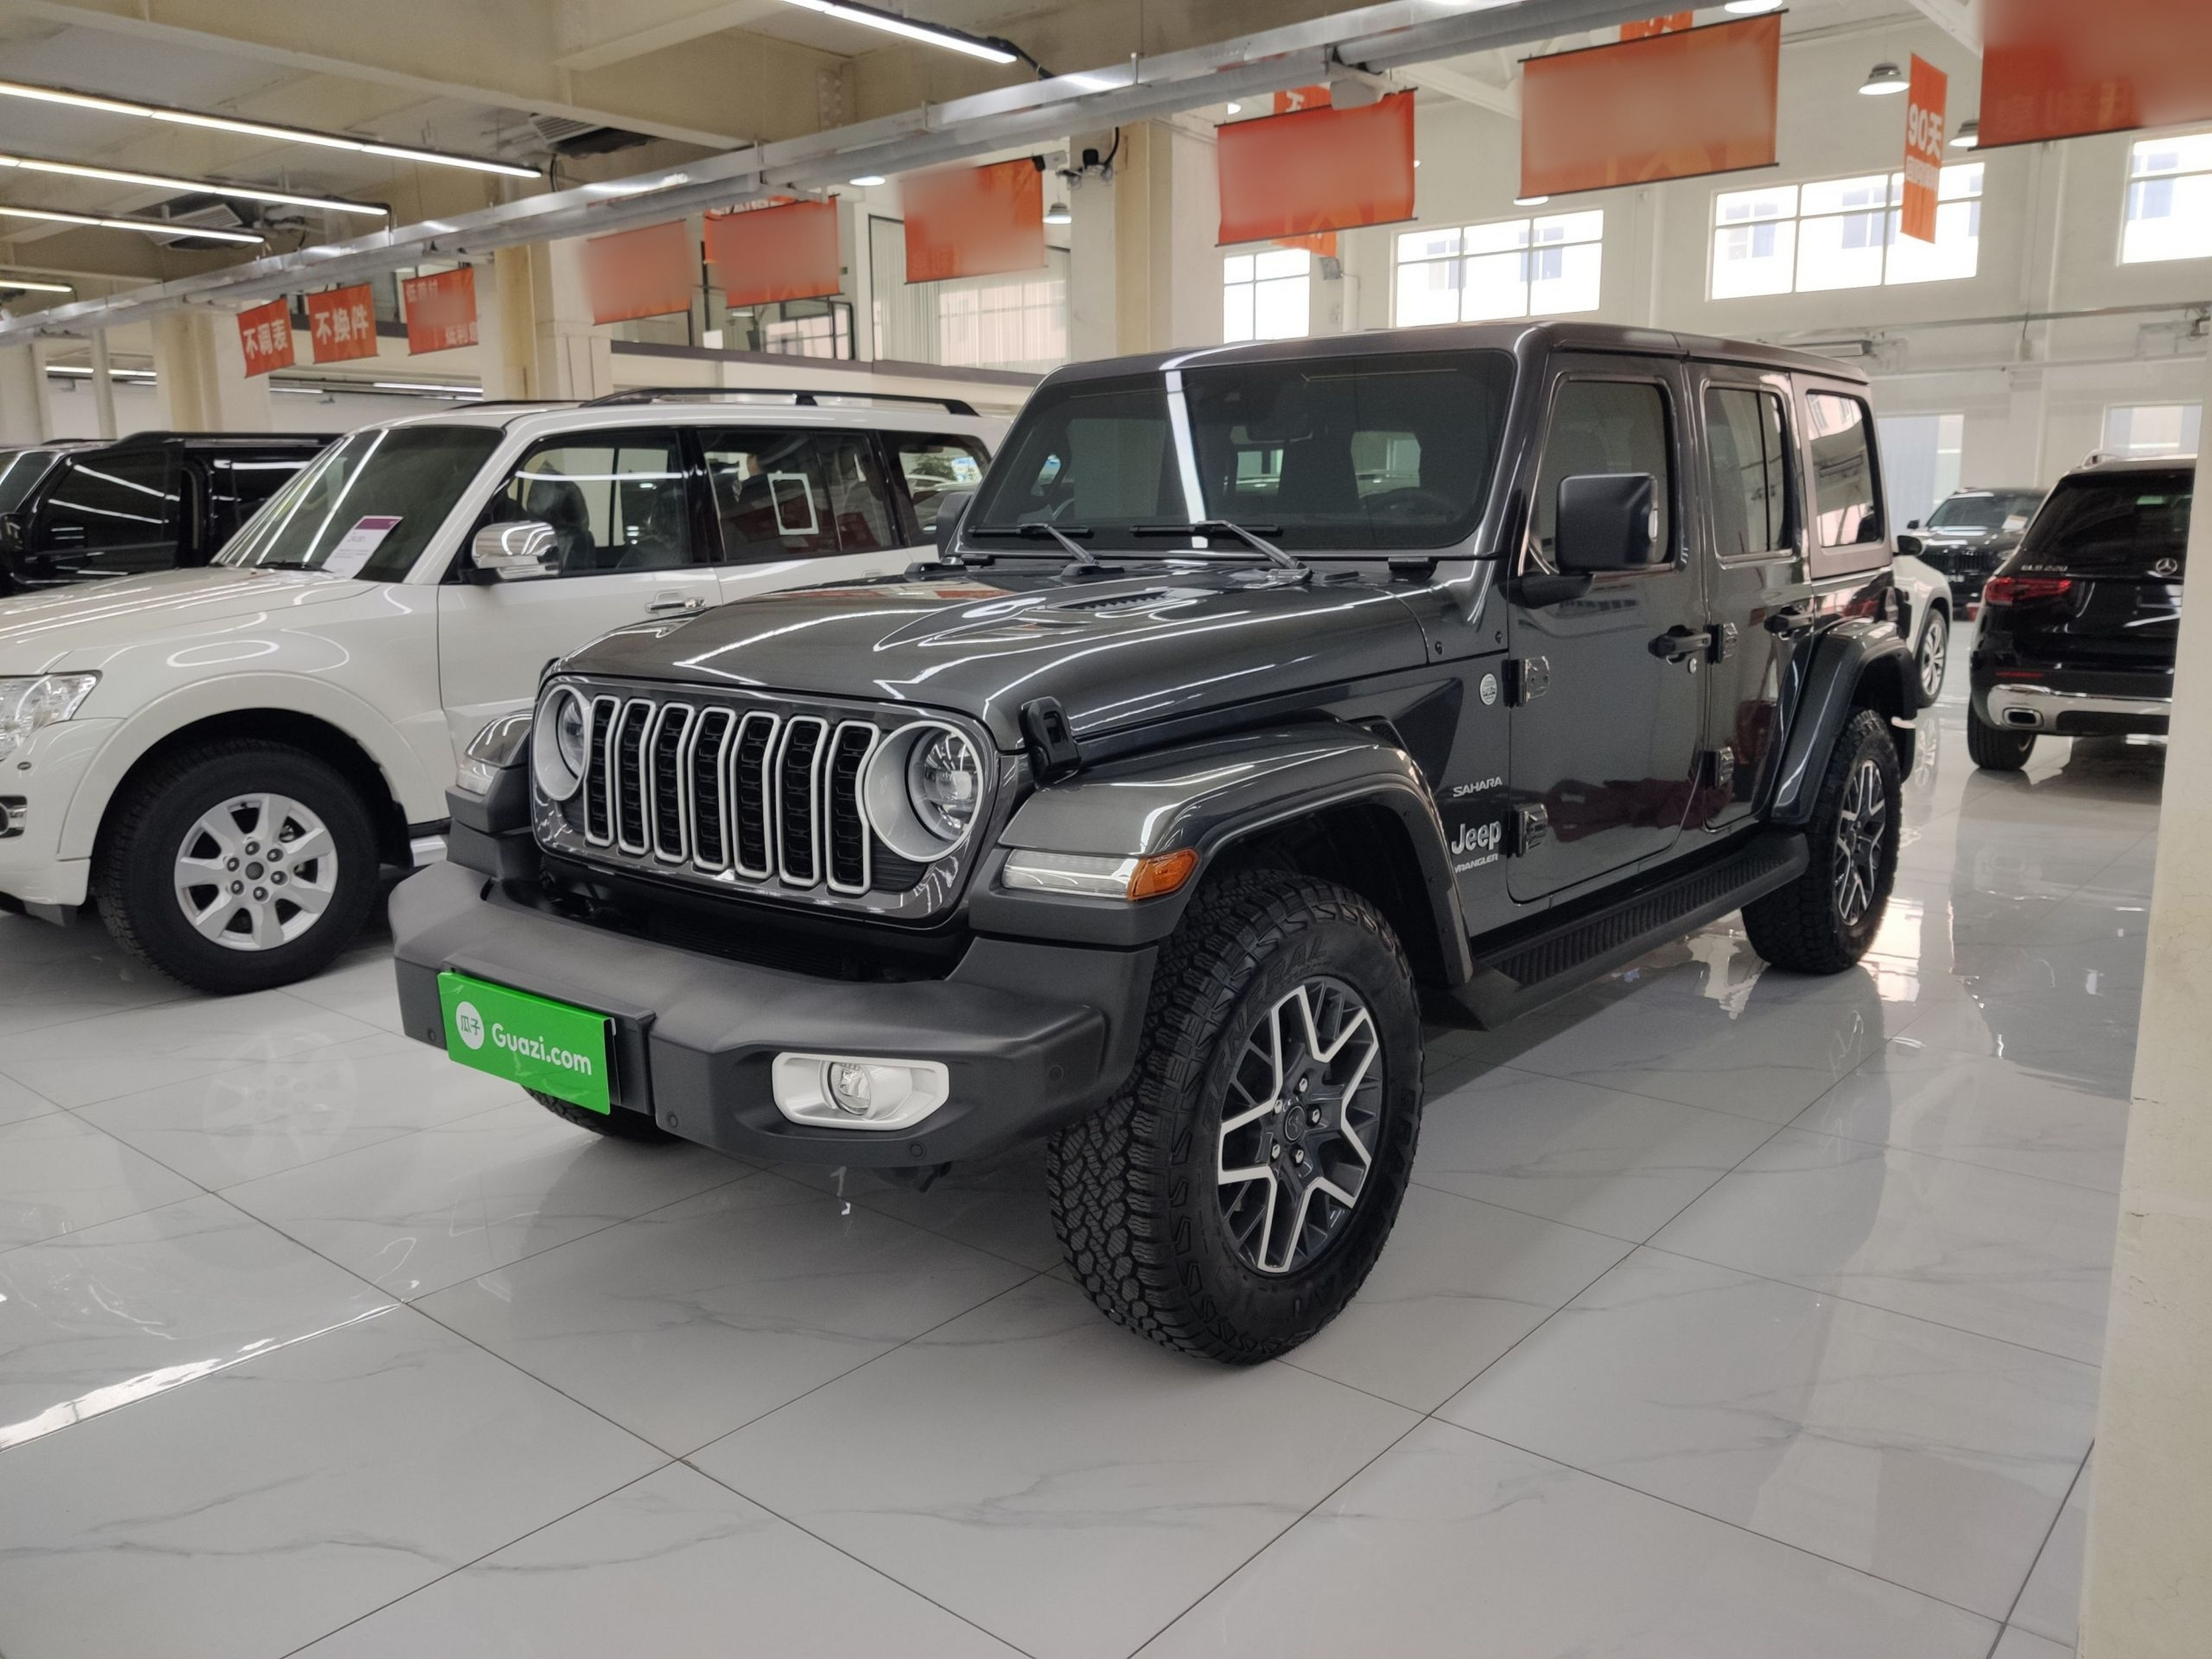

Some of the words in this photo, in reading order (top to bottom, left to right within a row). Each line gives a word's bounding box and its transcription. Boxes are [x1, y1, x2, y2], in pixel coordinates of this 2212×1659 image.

[1908, 103, 1942, 160] 90天
[315, 304, 369, 345] 不换件
[1453, 777, 1502, 797] SAHARA
[1451, 821, 1501, 854] Jeep
[461, 1015, 480, 1036] 瓜子
[492, 1023, 592, 1075] Guazi.com
